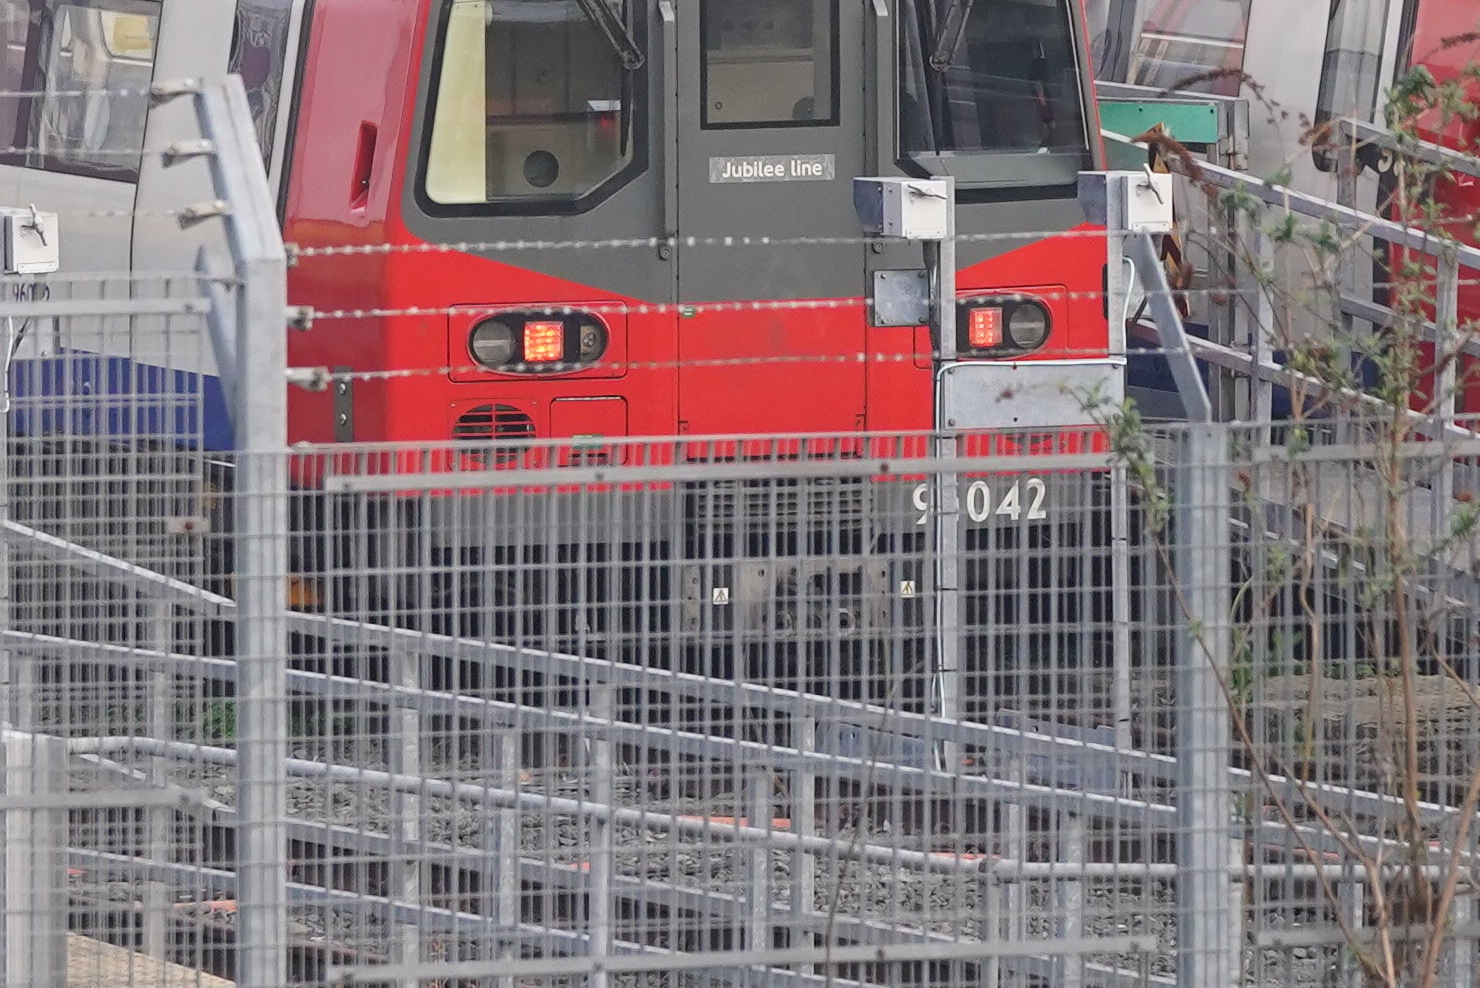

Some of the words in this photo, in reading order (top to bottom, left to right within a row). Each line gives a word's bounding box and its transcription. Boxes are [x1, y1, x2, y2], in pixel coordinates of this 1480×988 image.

[722, 161, 785, 178] Jubilee
[790, 160, 823, 176] line
[912, 478, 1047, 525] 9042
